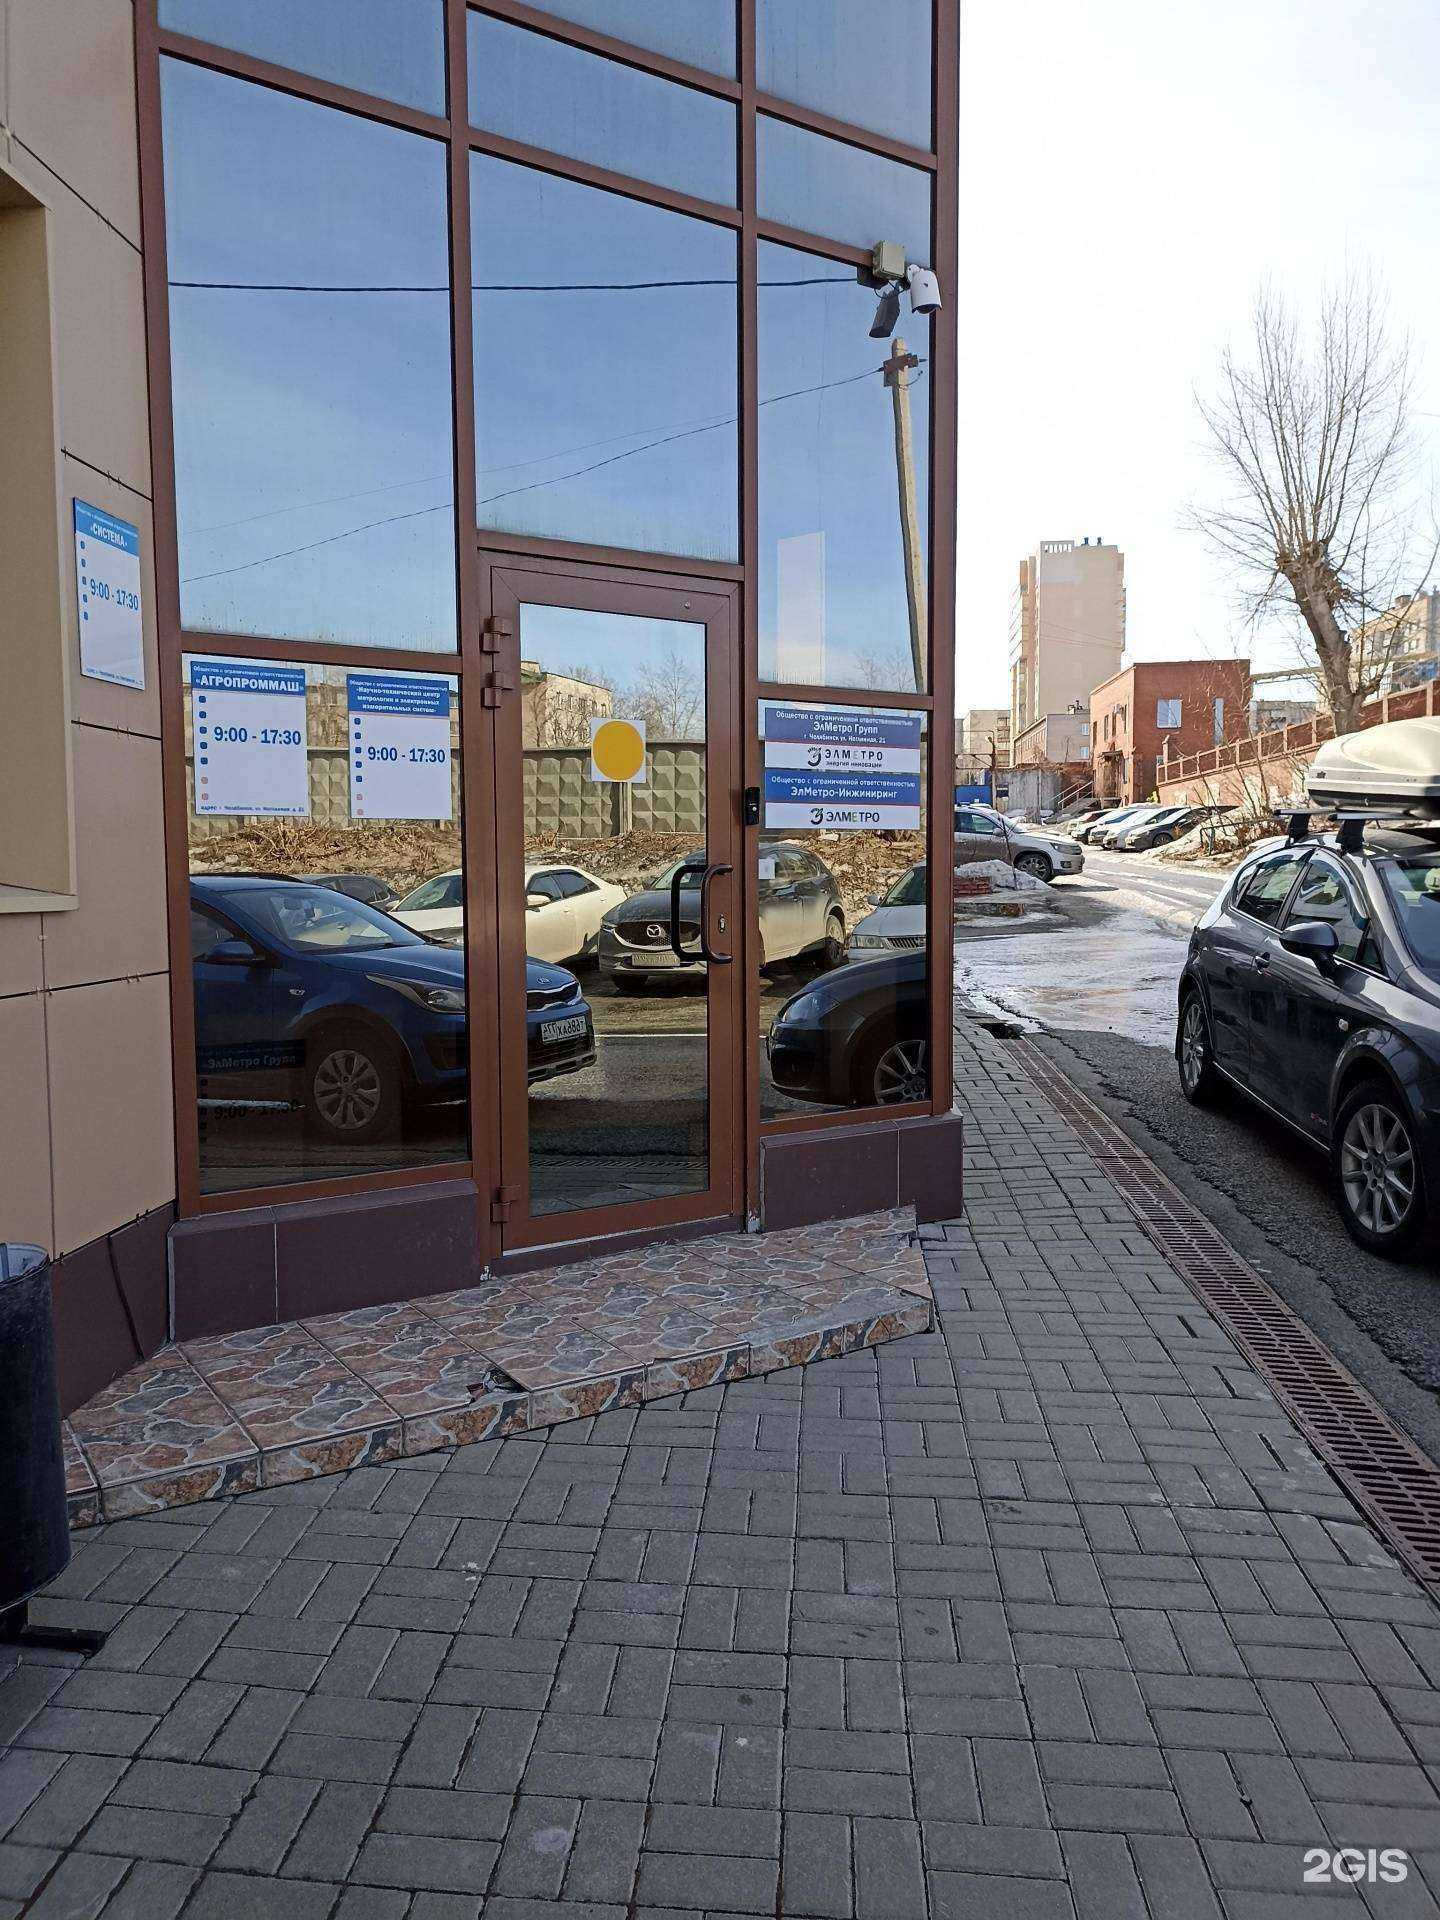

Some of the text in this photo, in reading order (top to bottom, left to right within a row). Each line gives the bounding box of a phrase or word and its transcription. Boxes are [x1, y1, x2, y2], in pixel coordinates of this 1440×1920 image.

[90, 578, 110, 600] 9:00
[116, 589, 139, 610] 17:30
[776, 710, 809, 720] Общество
[814, 714, 859, 724] ограниченной
[814, 721, 878, 736] ЭлМетро Групп
[213, 726, 248, 743] 9:00
[260, 728, 302, 746] 17:30
[367, 746, 398, 761] 9:00
[409, 748, 446, 763] 17:30
[824, 748, 883, 761] ЭЛМЕТРО
[771, 776, 806, 784] Общество
[812, 778, 858, 786] ограниченной
[860, 780, 916, 788] ответственностью
[790, 786, 898, 799] ЭлМетро-Инжиниринг
[826, 812, 880, 823] ЭЛМЕТРО
[208, 1055, 296, 1069] ЭлМетро Групп
